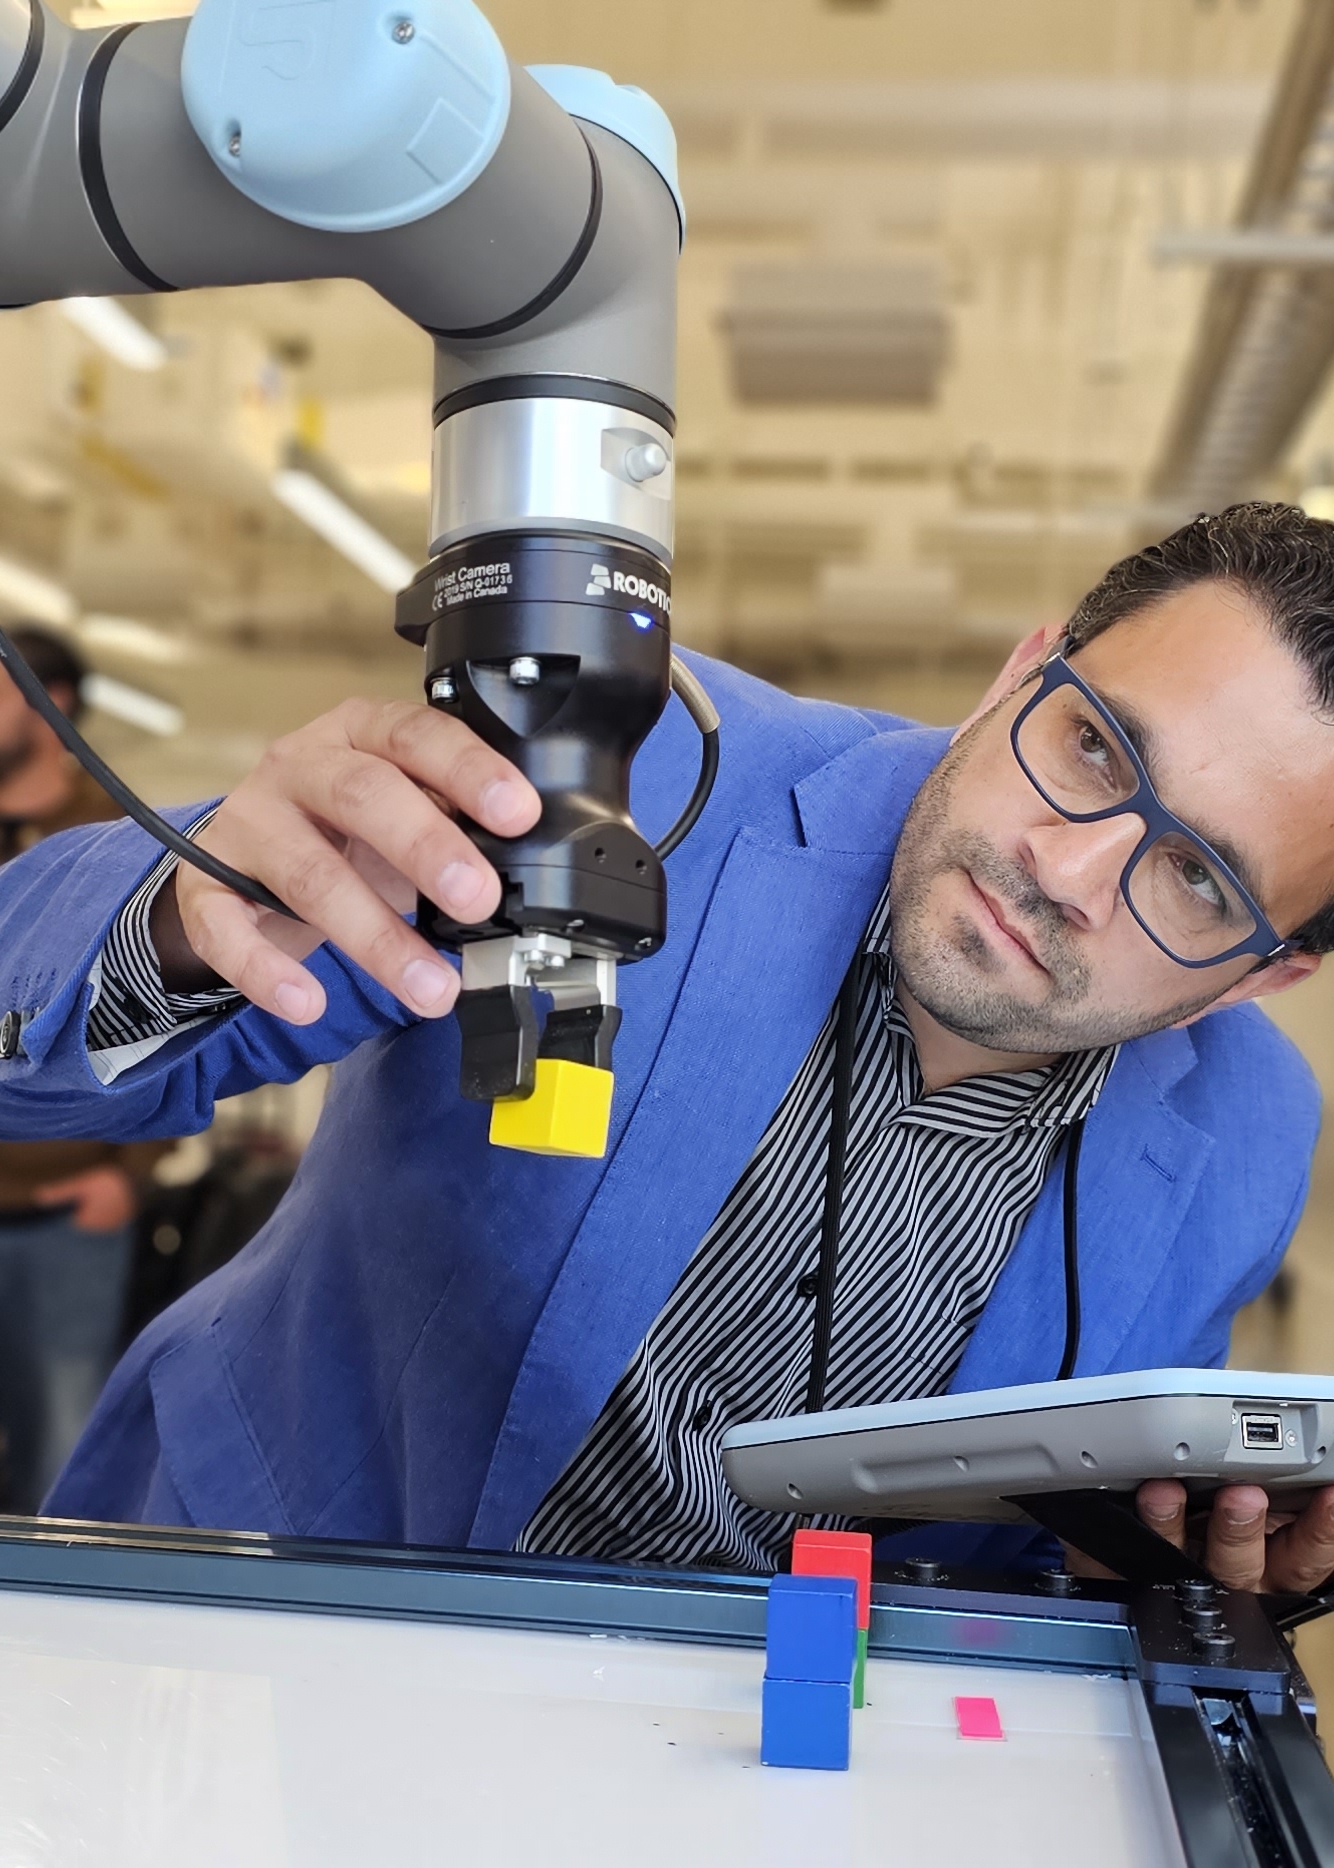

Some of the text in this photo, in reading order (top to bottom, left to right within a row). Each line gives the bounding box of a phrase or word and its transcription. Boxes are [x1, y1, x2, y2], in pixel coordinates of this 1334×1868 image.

[435, 562, 510, 591] Wrist Camera
[446, 585, 508, 605] Made in Canada
